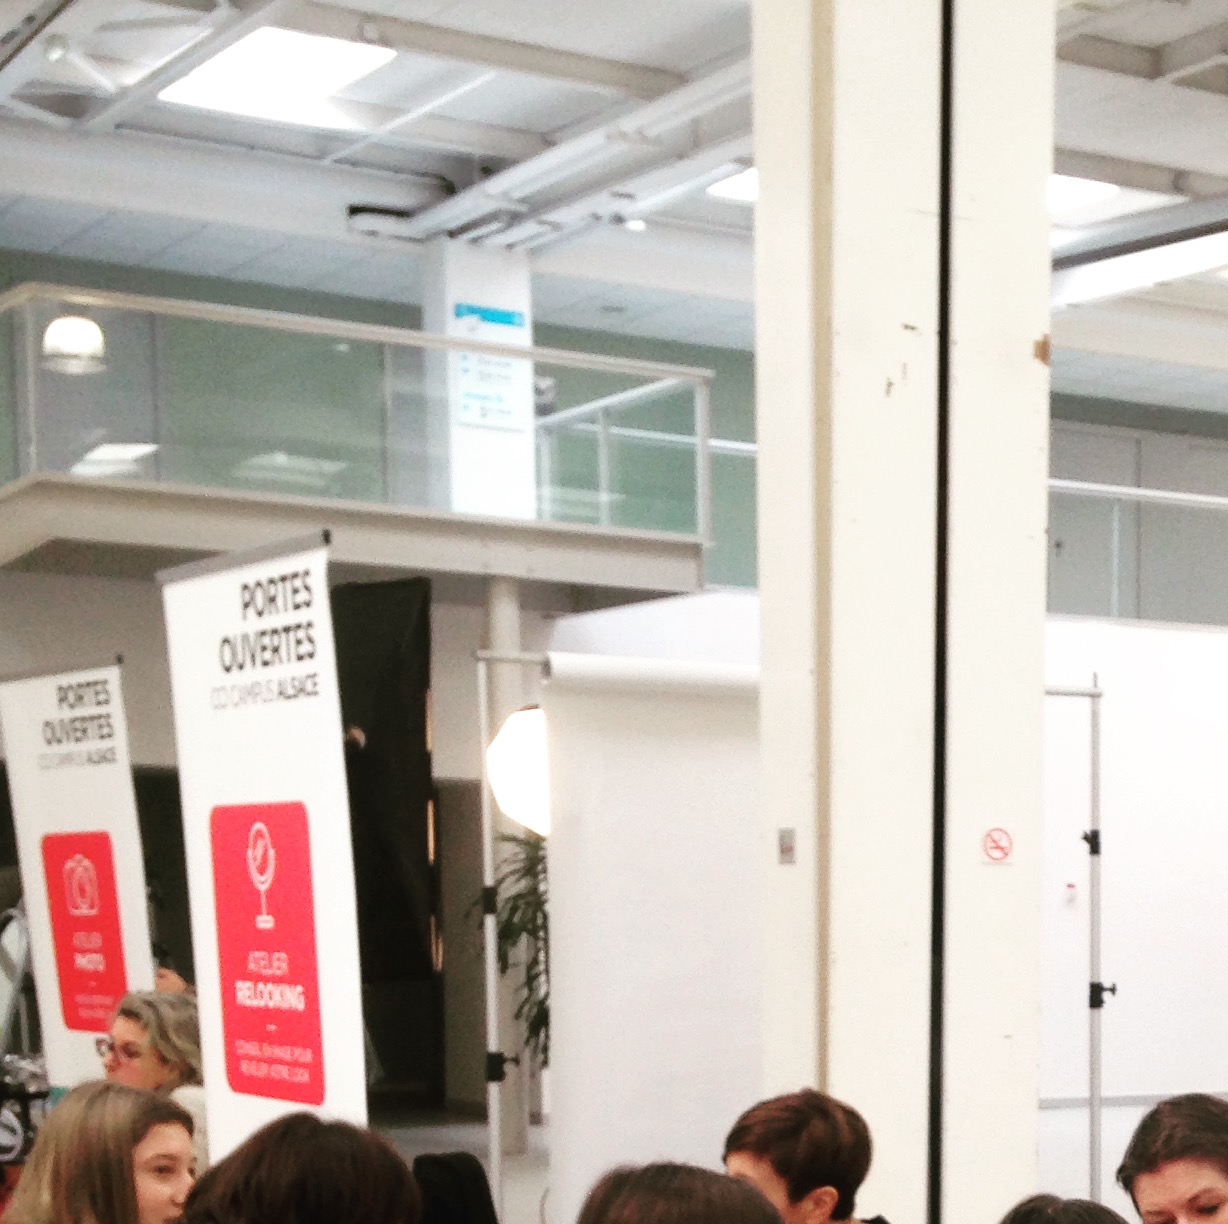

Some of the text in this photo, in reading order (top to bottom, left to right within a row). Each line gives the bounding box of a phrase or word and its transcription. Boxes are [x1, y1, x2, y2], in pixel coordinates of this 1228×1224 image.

[241, 568, 312, 620] PORTES
[220, 620, 315, 673] OUVERTES
[235, 980, 305, 1012] RELOOKING
